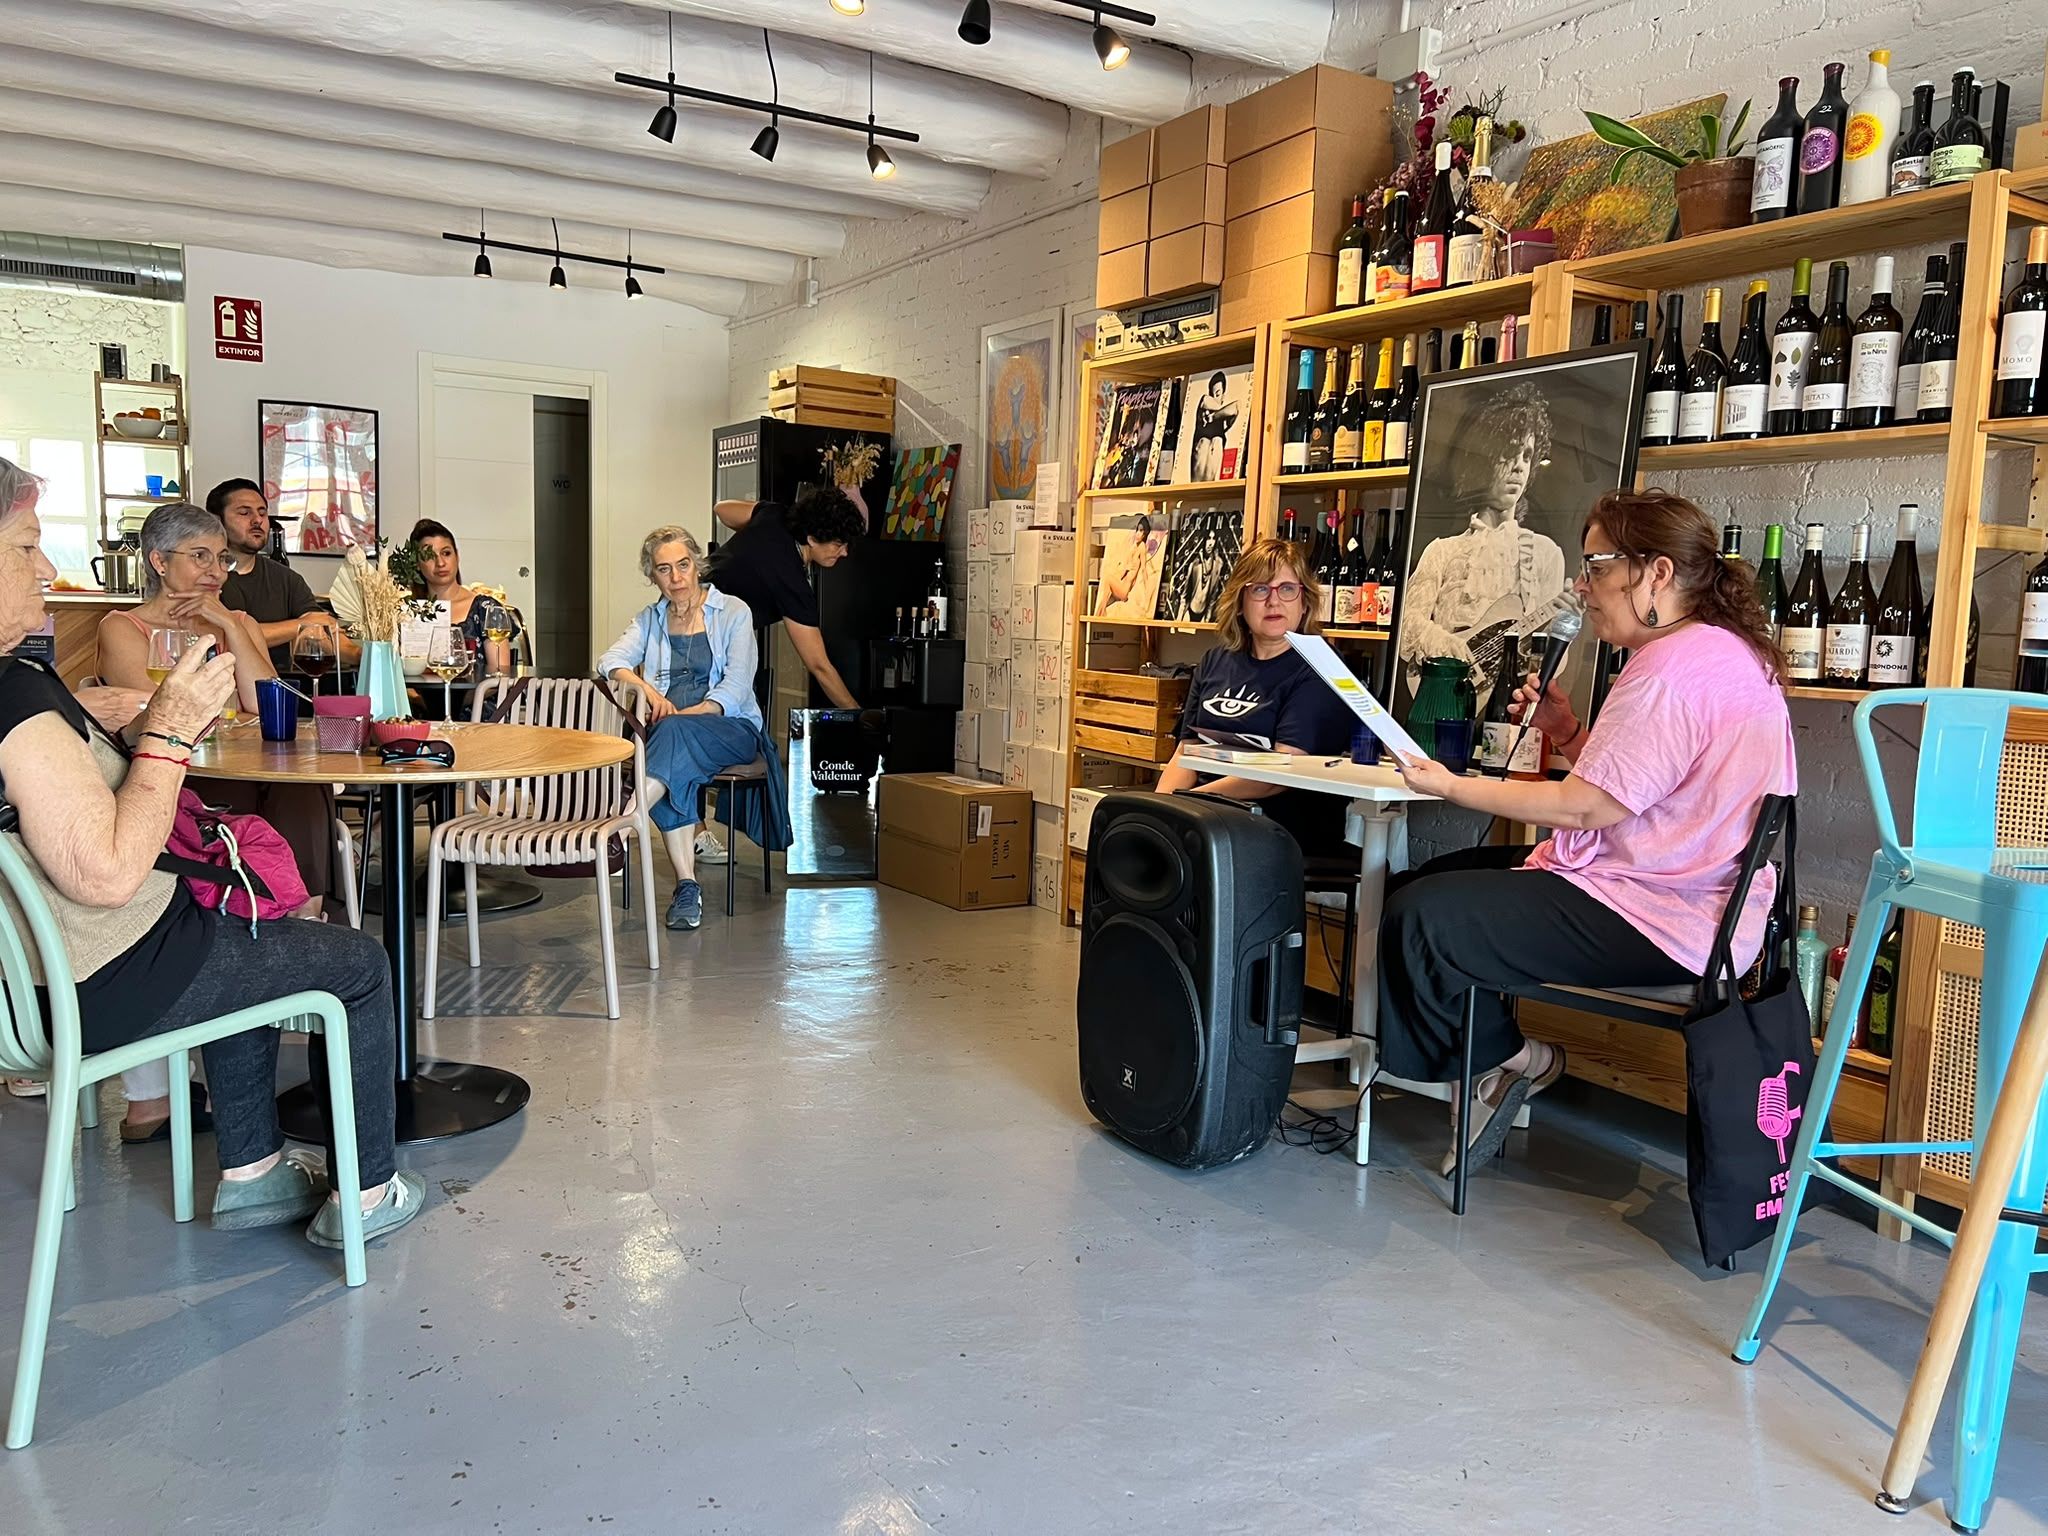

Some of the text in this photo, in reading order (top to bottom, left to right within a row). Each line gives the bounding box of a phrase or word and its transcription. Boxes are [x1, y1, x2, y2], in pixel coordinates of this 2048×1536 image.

[218, 346, 260, 357] EXTINTOR
[552, 479, 570, 489] WC
[819, 759, 855, 771] Conde
[811, 770, 863, 781] Valdemar
[1756, 1197, 1785, 1221] EM
